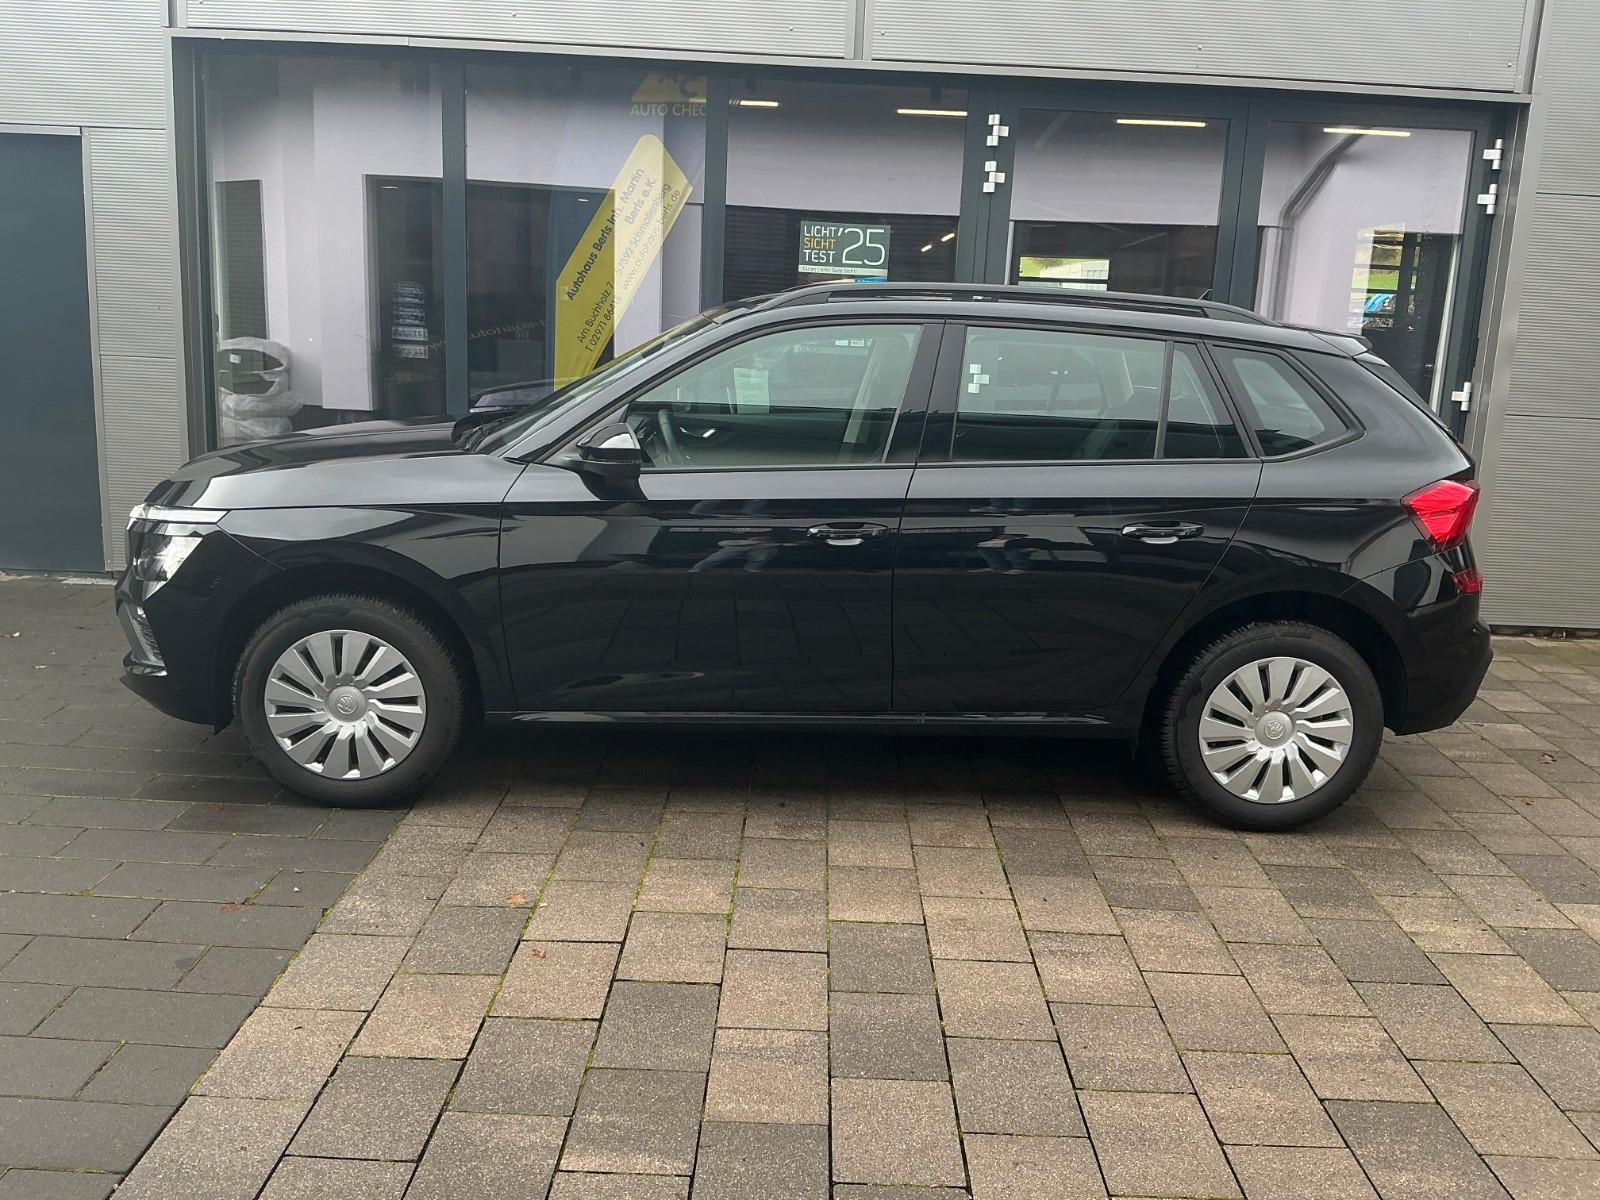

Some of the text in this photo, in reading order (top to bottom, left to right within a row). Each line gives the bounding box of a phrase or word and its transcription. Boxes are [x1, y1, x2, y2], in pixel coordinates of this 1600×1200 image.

[630, 103, 668, 117] AUTO
[625, 198, 645, 225] Berls
[566, 252, 598, 301] Autohaus
[593, 223, 613, 252] Berls
[620, 168, 645, 203] Martin
[804, 225, 837, 238] LICHT
[804, 237, 837, 250] SICHT
[803, 249, 837, 264] TEST
[576, 328, 589, 344] Am
[585, 289, 610, 328] Buchholz
[589, 321, 608, 346] 02971
